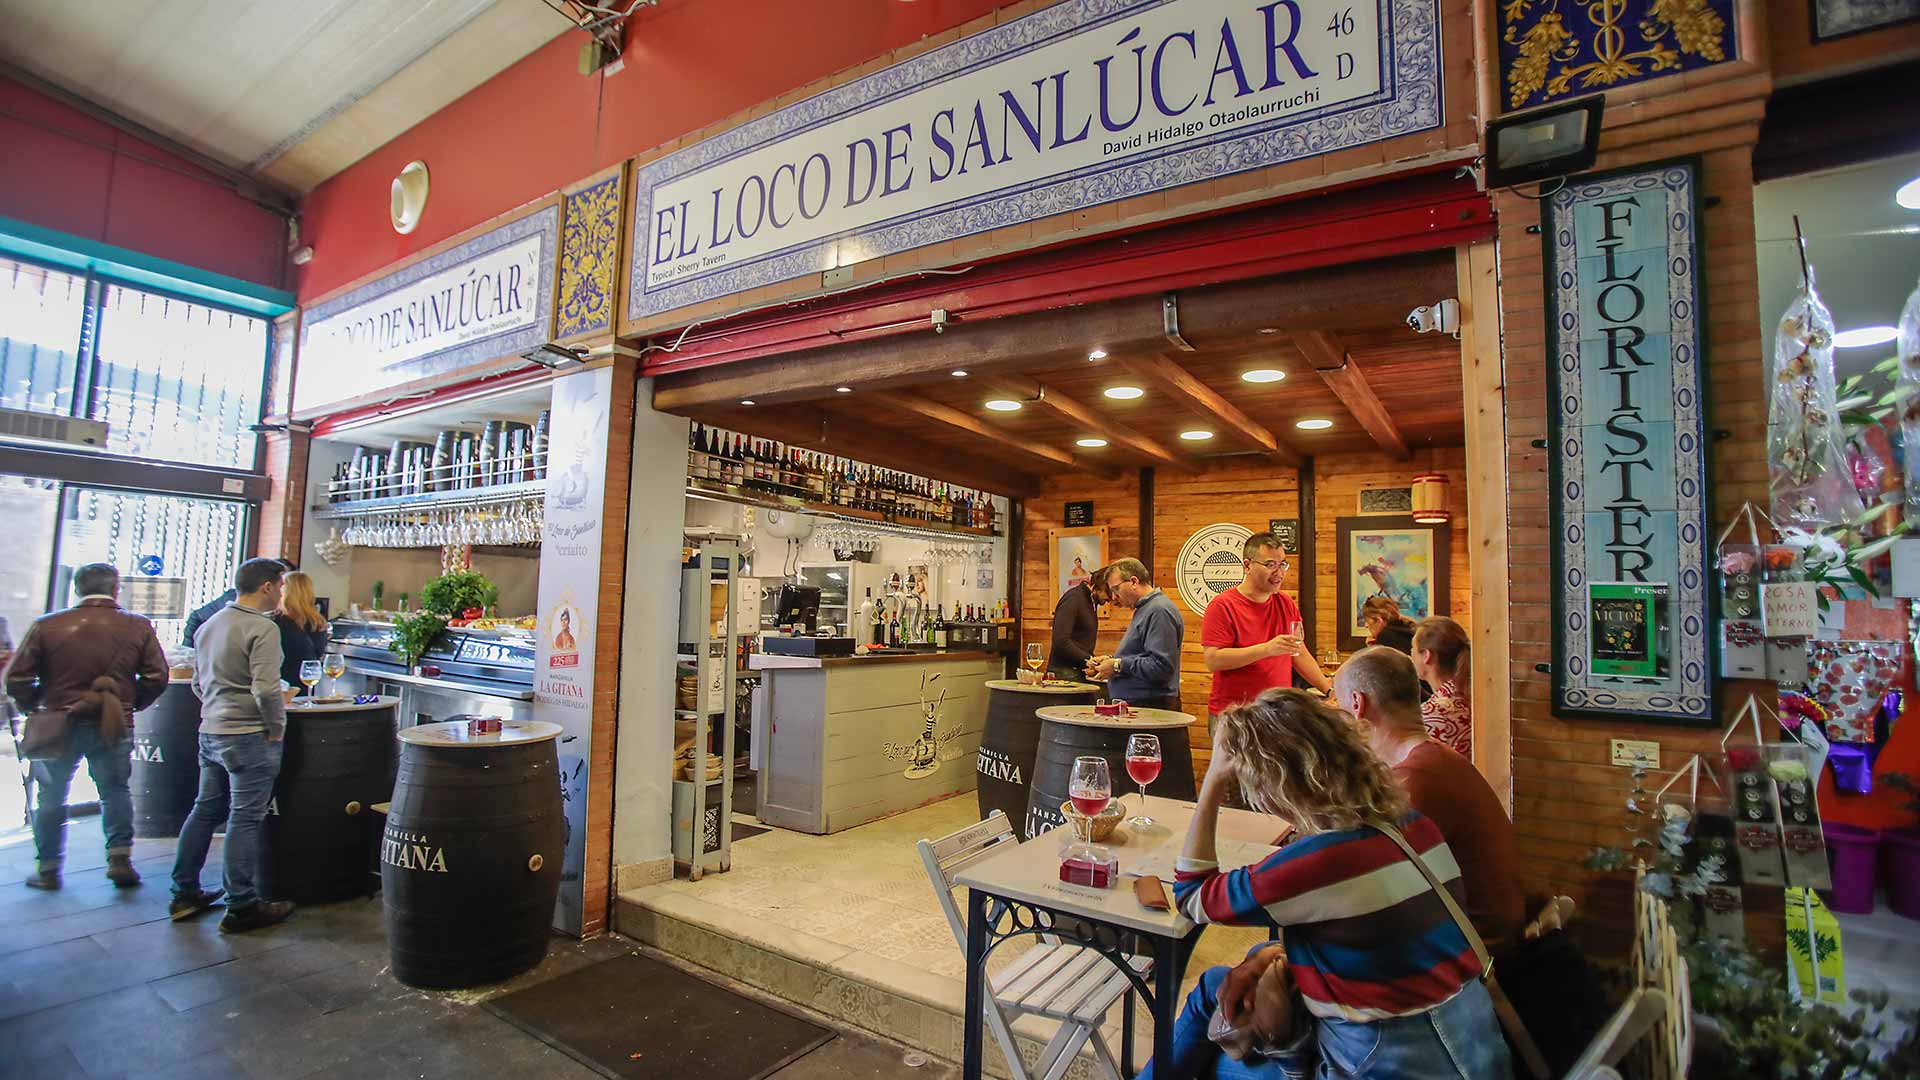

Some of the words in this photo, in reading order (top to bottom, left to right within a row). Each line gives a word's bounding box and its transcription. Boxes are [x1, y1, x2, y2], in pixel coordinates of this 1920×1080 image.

[1326, 7, 1355, 38] 46
[1336, 52, 1354, 81] D
[652, 200, 700, 266] EL
[708, 153, 832, 249] LOCO
[843, 123, 914, 209] DE
[929, 0, 1319, 184] SANLÚCAR
[1103, 135, 1142, 155] David
[1147, 119, 1204, 145] Hidalgo
[1209, 87, 1320, 128] Otaolaurruchi
[652, 265, 675, 283] Typical
[676, 260, 700, 277] Sherry
[702, 253, 726, 268] Tavern
[379, 307, 403, 353] DE
[405, 263, 523, 344] SANLÚCAR
[1594, 196, 1661, 685] FLORISTER
[1764, 586, 1806, 599] ROSA
[1766, 602, 1808, 614] AMOR
[1766, 619, 1814, 628] ETERNO
[540, 680, 551, 694] LA
[552, 682, 584, 698] GITANA
[1032, 806, 1065, 824] MANZA
